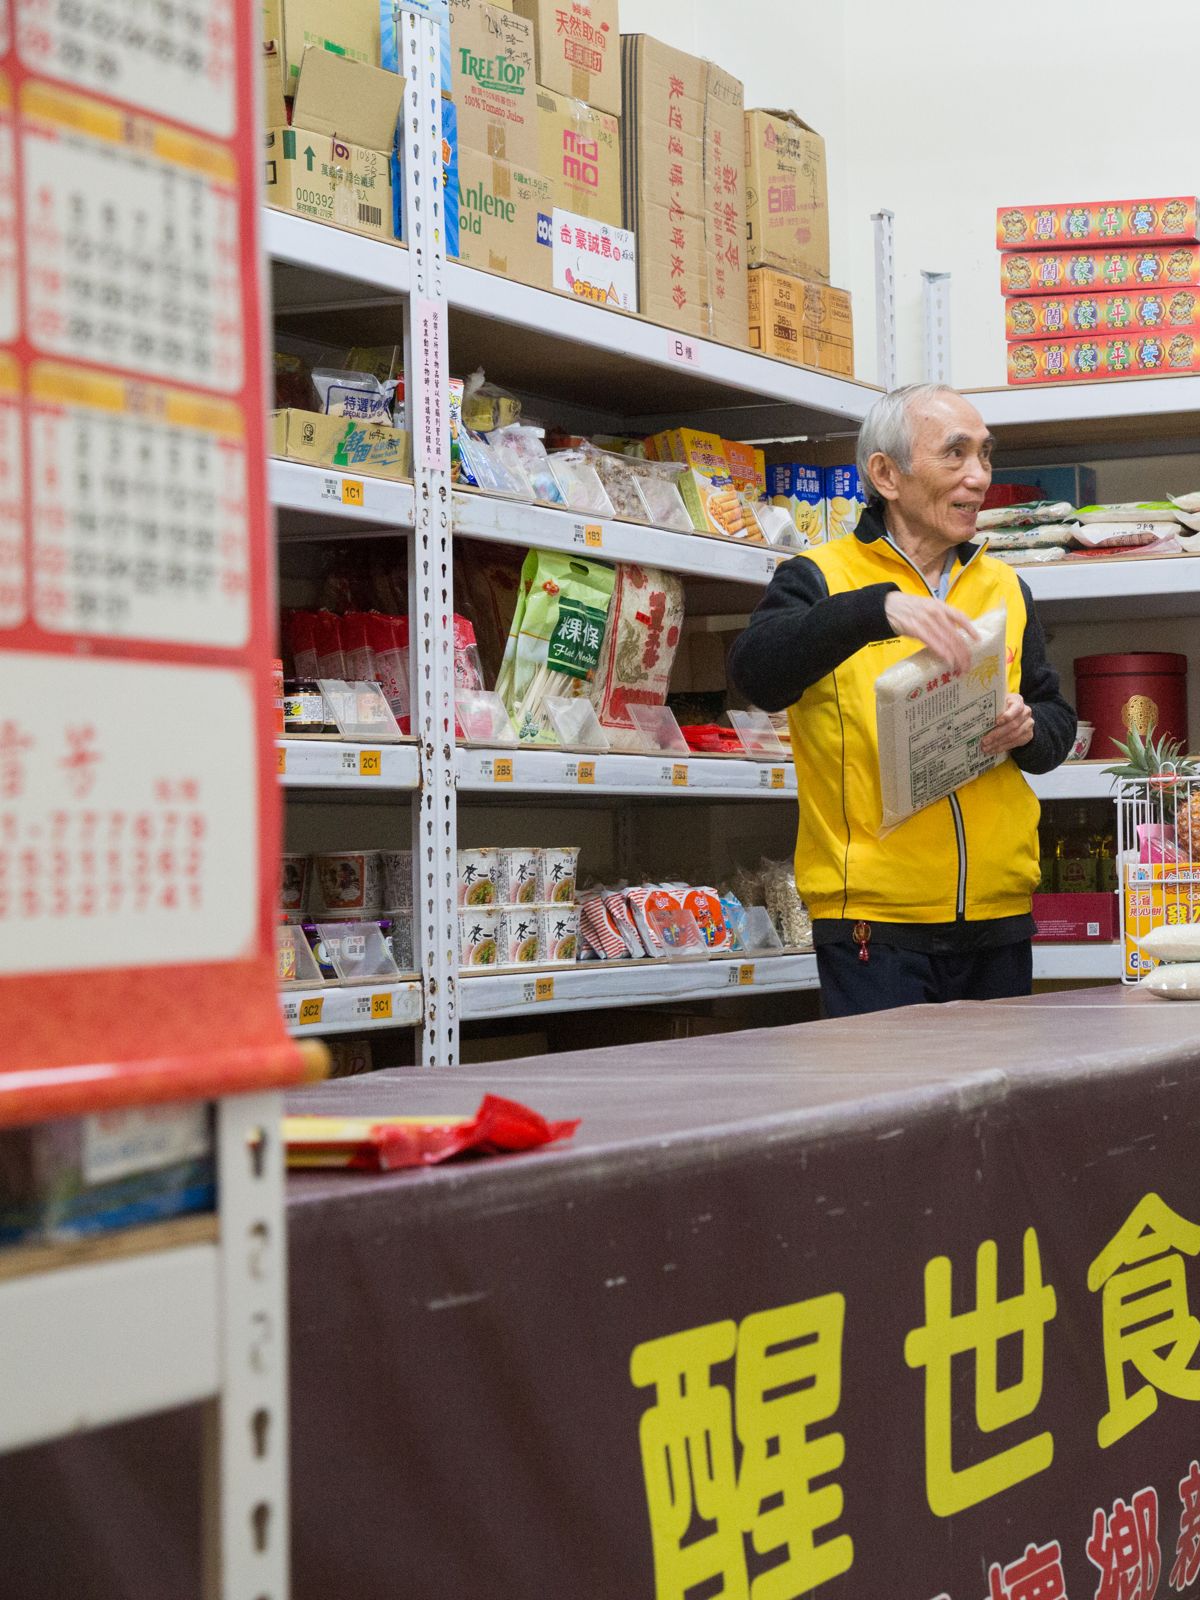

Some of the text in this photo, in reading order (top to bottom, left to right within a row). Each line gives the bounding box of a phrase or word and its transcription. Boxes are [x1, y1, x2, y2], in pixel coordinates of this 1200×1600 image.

[555, 9, 606, 48] 天然取向
[459, 47, 495, 81] TREE
[495, 54, 525, 85] TOP
[464, 95, 525, 124] 100% Tomato Juice
[296, 187, 334, 209] 000392
[459, 213, 482, 235] old
[1037, 211, 1152, 235] 闔家平安
[1042, 259, 1158, 282] 闔家平安
[1046, 302, 1160, 327] 闔家平安
[1047, 346, 1160, 370] 闔家平安
[345, 486, 360, 499] 1C1
[557, 615, 600, 650] 粿條
[552, 643, 597, 665] Flat Noodles
[362, 757, 378, 769] 2C1
[303, 1005, 319, 1017] 3C2
[374, 1001, 389, 1012] 3C1
